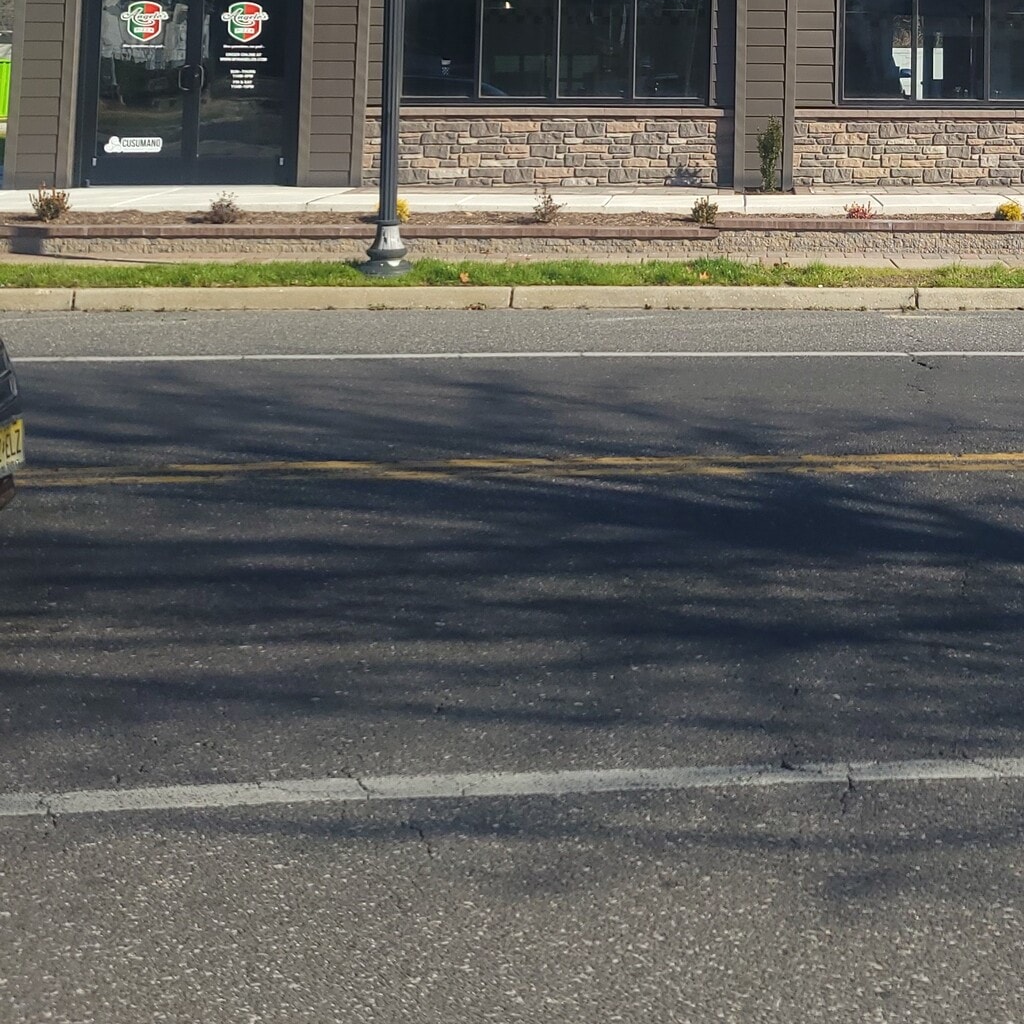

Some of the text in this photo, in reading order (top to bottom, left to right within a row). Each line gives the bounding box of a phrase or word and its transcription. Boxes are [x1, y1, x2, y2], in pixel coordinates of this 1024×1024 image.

[121, 7, 169, 26] Angelo's
[221, 7, 269, 27] Angelo's
[122, 138, 161, 147] CUSUMANO
